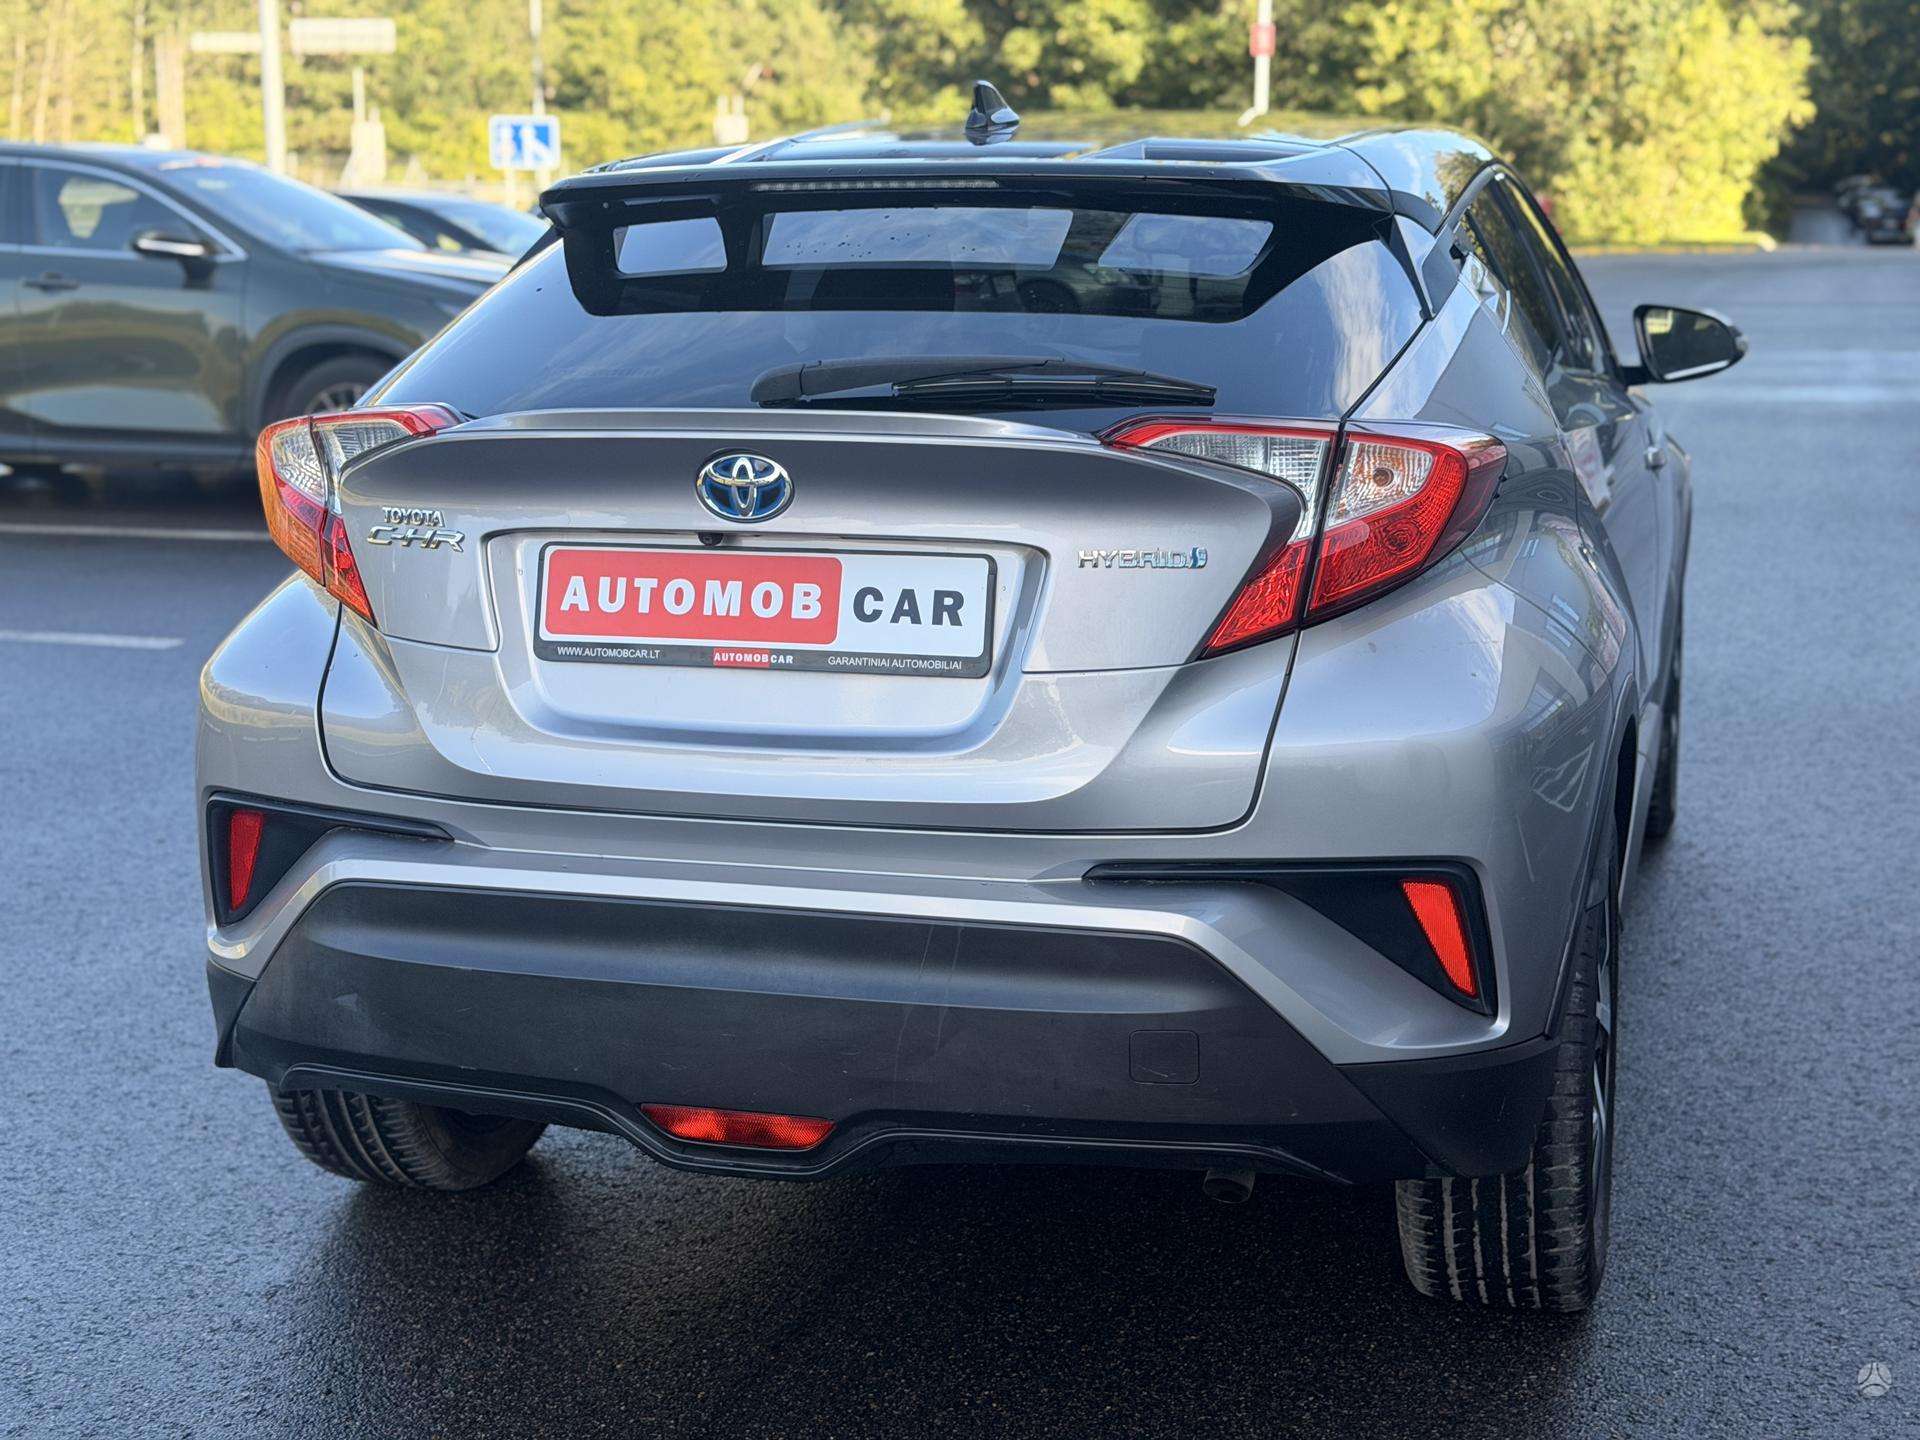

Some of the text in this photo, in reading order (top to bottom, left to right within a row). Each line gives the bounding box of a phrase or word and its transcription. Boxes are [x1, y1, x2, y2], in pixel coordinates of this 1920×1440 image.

[382, 506, 445, 527] TOYOTA
[367, 526, 465, 552] C-HR
[1078, 549, 1187, 568] HYBRID
[560, 575, 965, 627] AUTOMOB CAR
[557, 646, 661, 660] WWW.AUTOMOBCAR.LT
[827, 655, 962, 670] GARANTINIAI AUTOMOBILIAI
